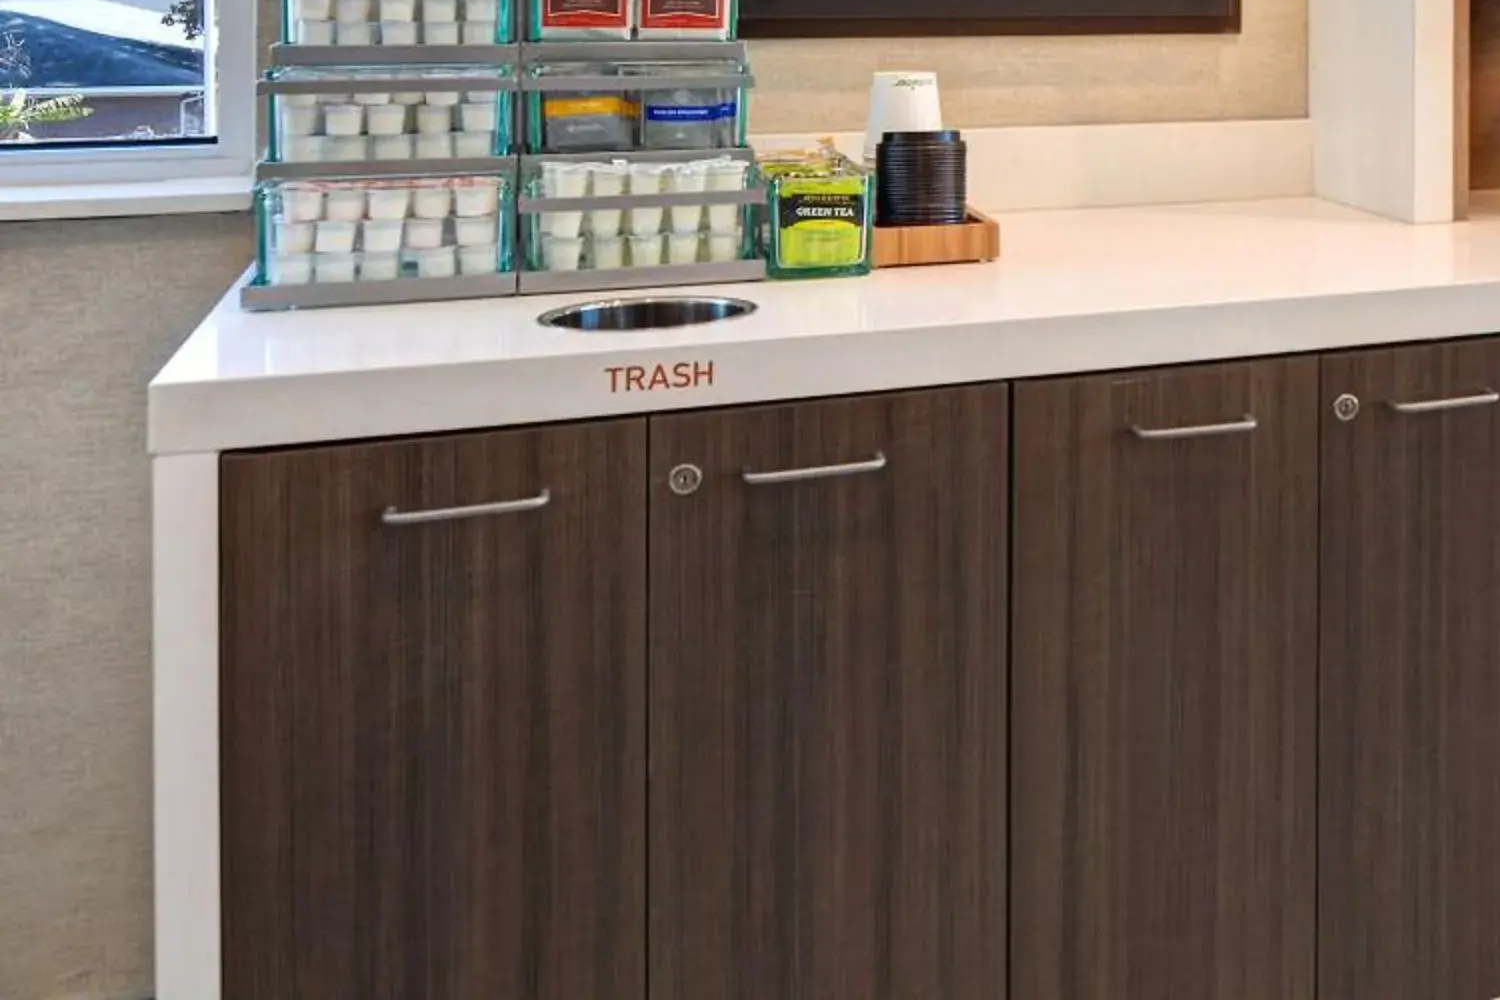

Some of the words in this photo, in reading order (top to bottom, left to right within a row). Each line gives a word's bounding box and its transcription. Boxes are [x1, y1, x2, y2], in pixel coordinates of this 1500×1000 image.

[795, 206, 833, 217] GREEN
[833, 206, 854, 217] TEA
[604, 360, 714, 393] TRASH
